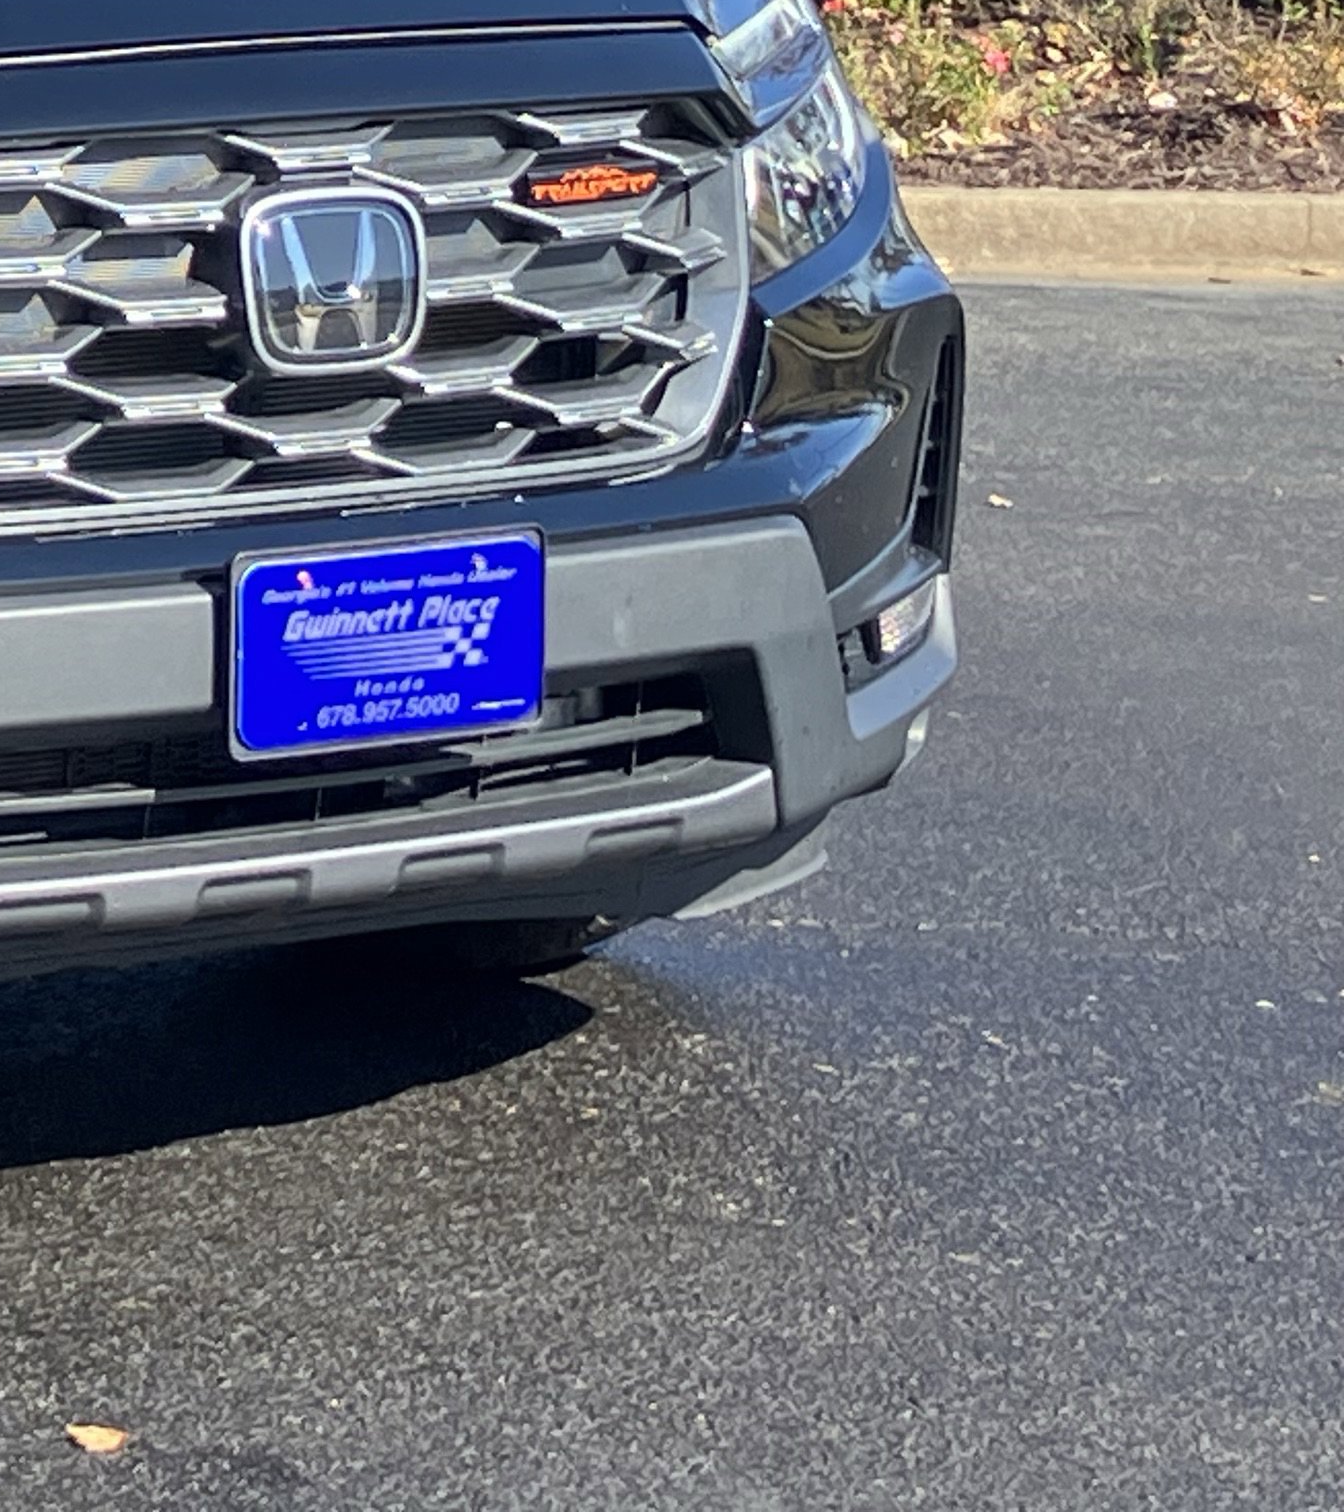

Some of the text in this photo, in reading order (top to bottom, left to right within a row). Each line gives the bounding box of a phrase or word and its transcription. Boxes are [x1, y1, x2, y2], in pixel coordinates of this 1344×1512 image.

[282, 594, 501, 643] Gwinnett Place
[354, 674, 425, 698] Honda
[316, 692, 460, 730] 678.957.5000
